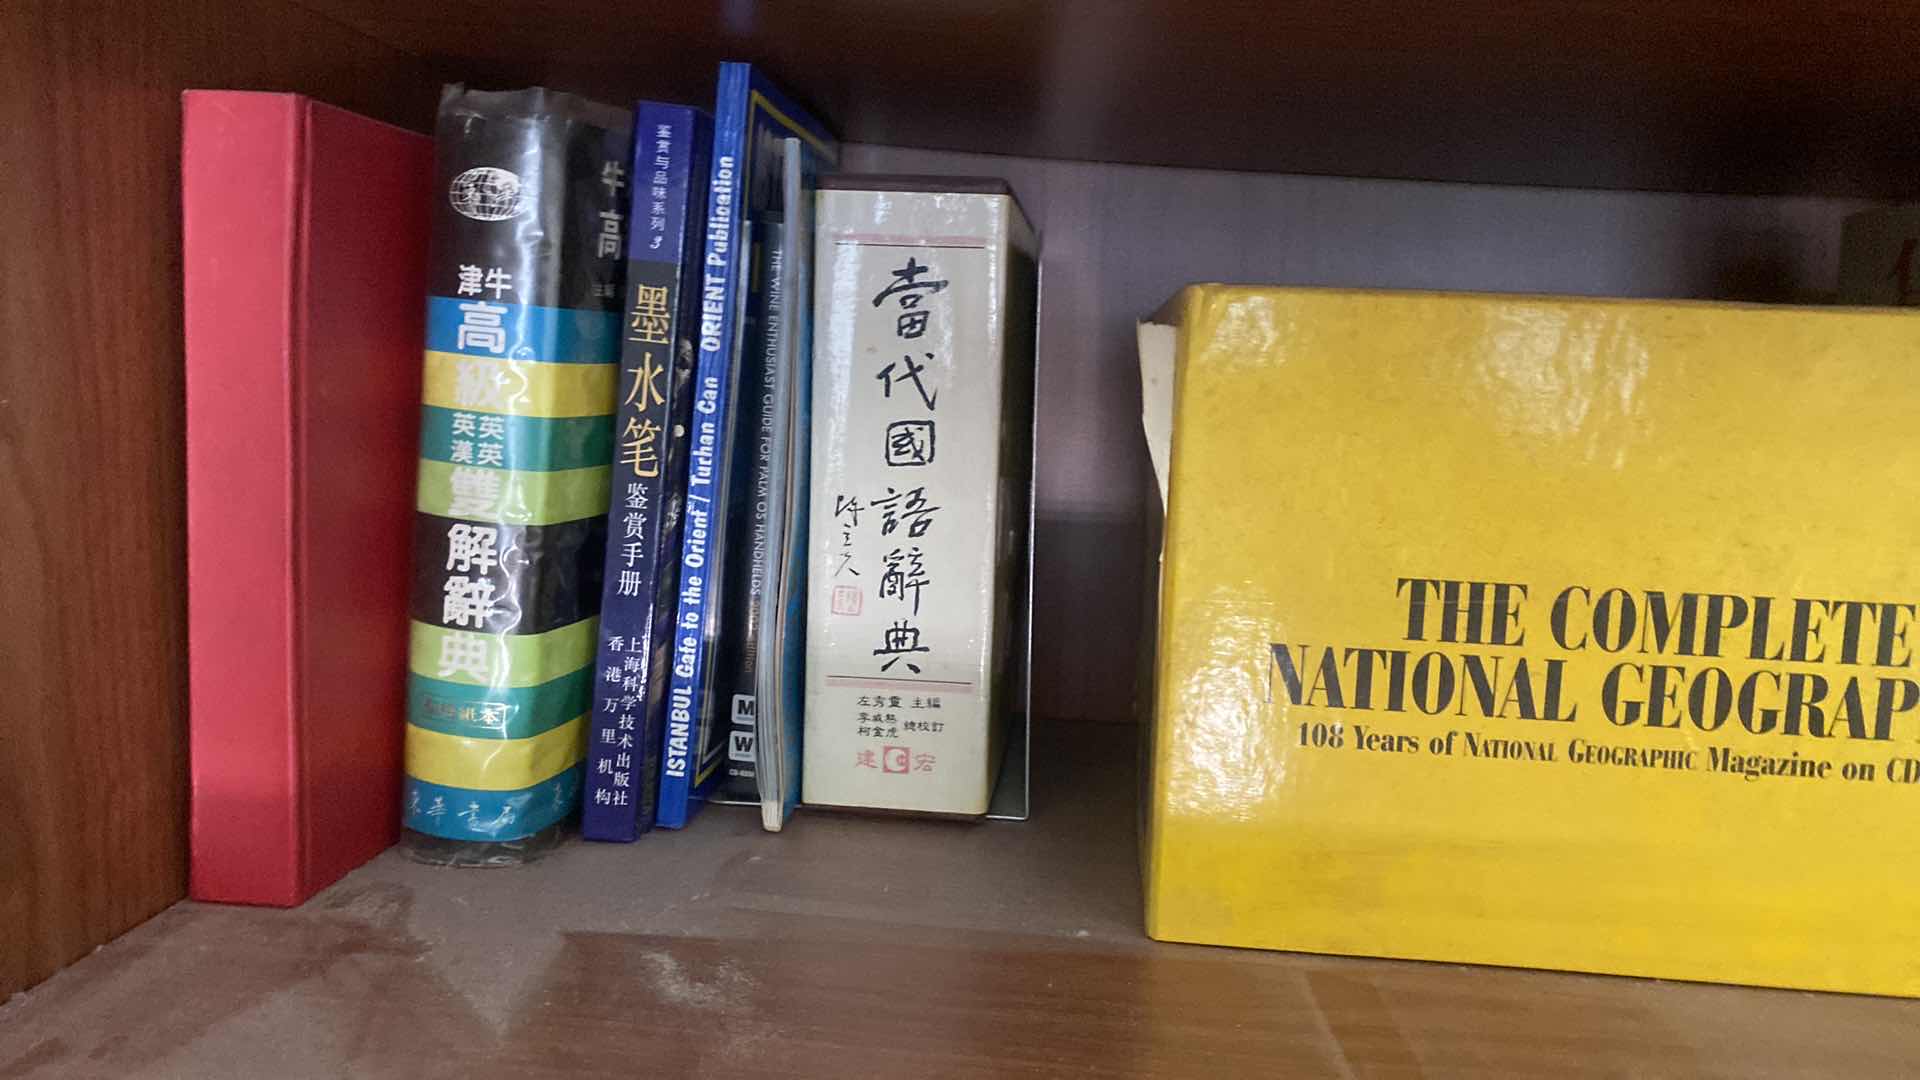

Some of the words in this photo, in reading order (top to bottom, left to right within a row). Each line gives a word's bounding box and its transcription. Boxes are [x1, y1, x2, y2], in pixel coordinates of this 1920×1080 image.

[706, 155, 735, 267] Publication
[649, 236, 663, 249] 3
[770, 249, 783, 272] THE
[700, 274, 726, 352] ORIENT
[768, 277, 781, 311] WINE
[620, 283, 671, 478] 墨水笔
[763, 315, 779, 388] ENTHUSIAST
[696, 376, 719, 415] Can
[760, 393, 774, 433] GUIDE
[759, 436, 773, 461] FOR
[870, 256, 949, 675] 當代國語辭典
[756, 466, 769, 497] PALM
[756, 502, 768, 520] OS
[616, 482, 649, 597] 鉴赏手册
[685, 509, 708, 568] Orient
[750, 524, 767, 596] HANDHELDS
[680, 611, 699, 630] to
[681, 575, 703, 605] the
[1395, 577, 1529, 647] THE
[1549, 585, 1918, 668] COMPLETE
[675, 636, 698, 678] Gate
[594, 636, 625, 805] 香港万里机构
[612, 637, 643, 806] 上海科学技术出版社
[1263, 642, 1578, 723] NATIONAL
[1601, 661, 1920, 743] GEOGRAP
[666, 686, 692, 777] ISTANBUL
[1299, 721, 1345, 749] 108
[1352, 724, 1420, 754] Years
[1429, 731, 1459, 756] of
[1463, 732, 1559, 762] NATIONAL
[1568, 738, 1698, 770] GEOGRAPHIC
[1706, 746, 1832, 782] Magazine
[1841, 761, 1876, 782] on
